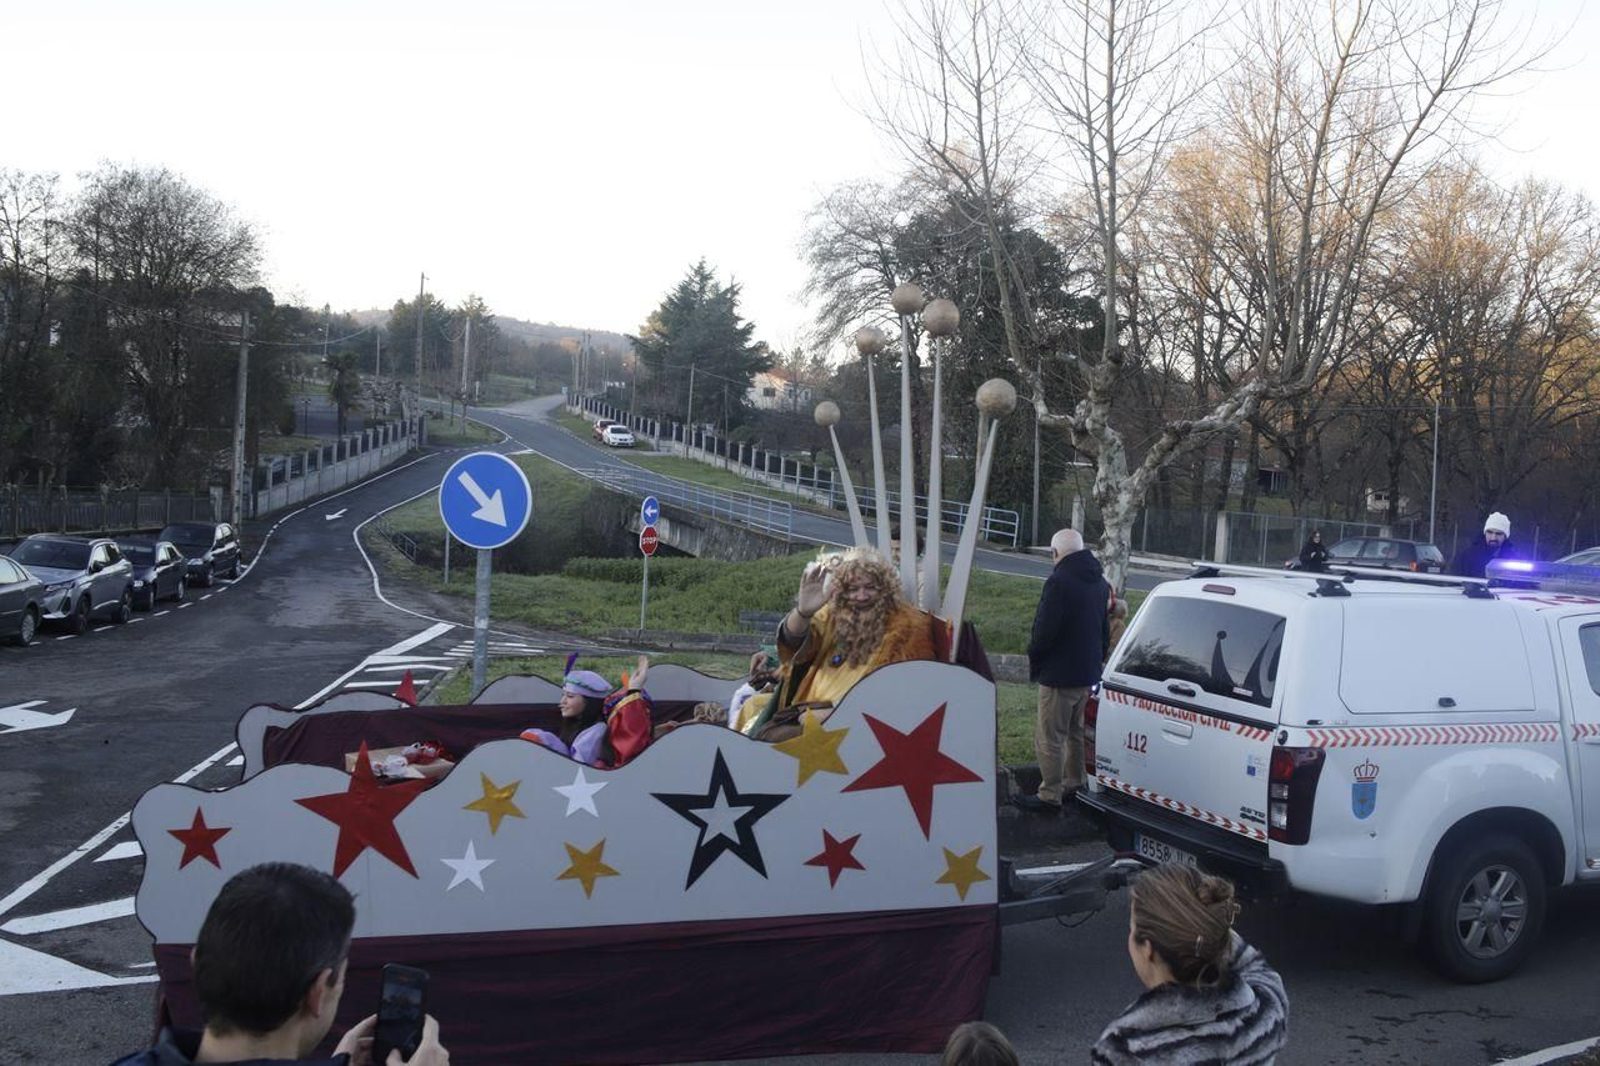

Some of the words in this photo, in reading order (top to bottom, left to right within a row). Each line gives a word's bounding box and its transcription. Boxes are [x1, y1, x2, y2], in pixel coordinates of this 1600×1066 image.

[642, 536, 657, 544] STOP
[1200, 713, 1231, 731] CIVIL
[1127, 731, 1148, 754] 112
